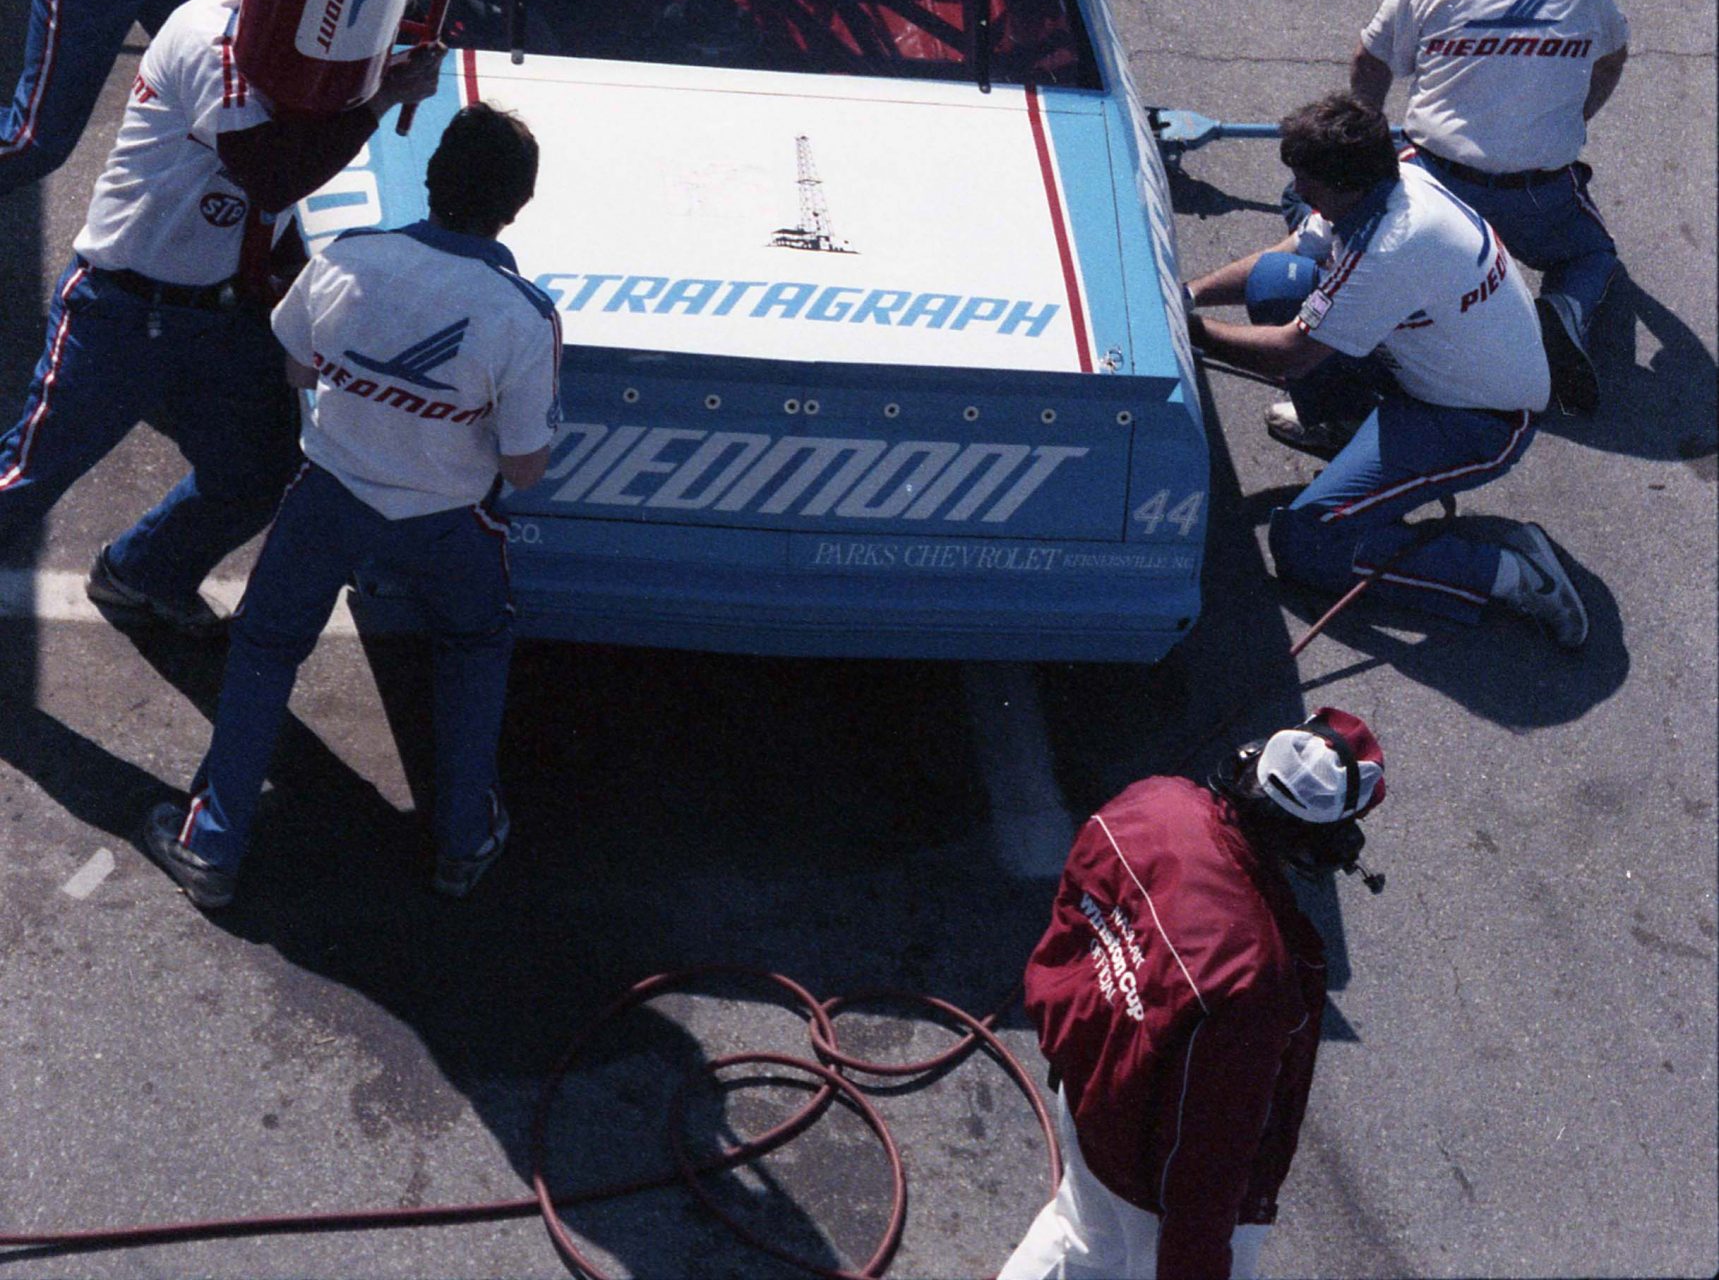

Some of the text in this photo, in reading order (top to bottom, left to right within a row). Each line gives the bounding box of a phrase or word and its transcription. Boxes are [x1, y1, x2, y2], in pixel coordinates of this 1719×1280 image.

[1425, 36, 1593, 59] PIEDMONT
[203, 196, 244, 223] STP
[535, 273, 1061, 340] STRATAGRAPH
[501, 422, 1090, 523] PIEDMONT
[1133, 489, 1206, 536] 44
[814, 543, 896, 569] PARKS
[903, 543, 1061, 573] CHEVROLET
[1079, 892, 1146, 1022] Winston Cup
